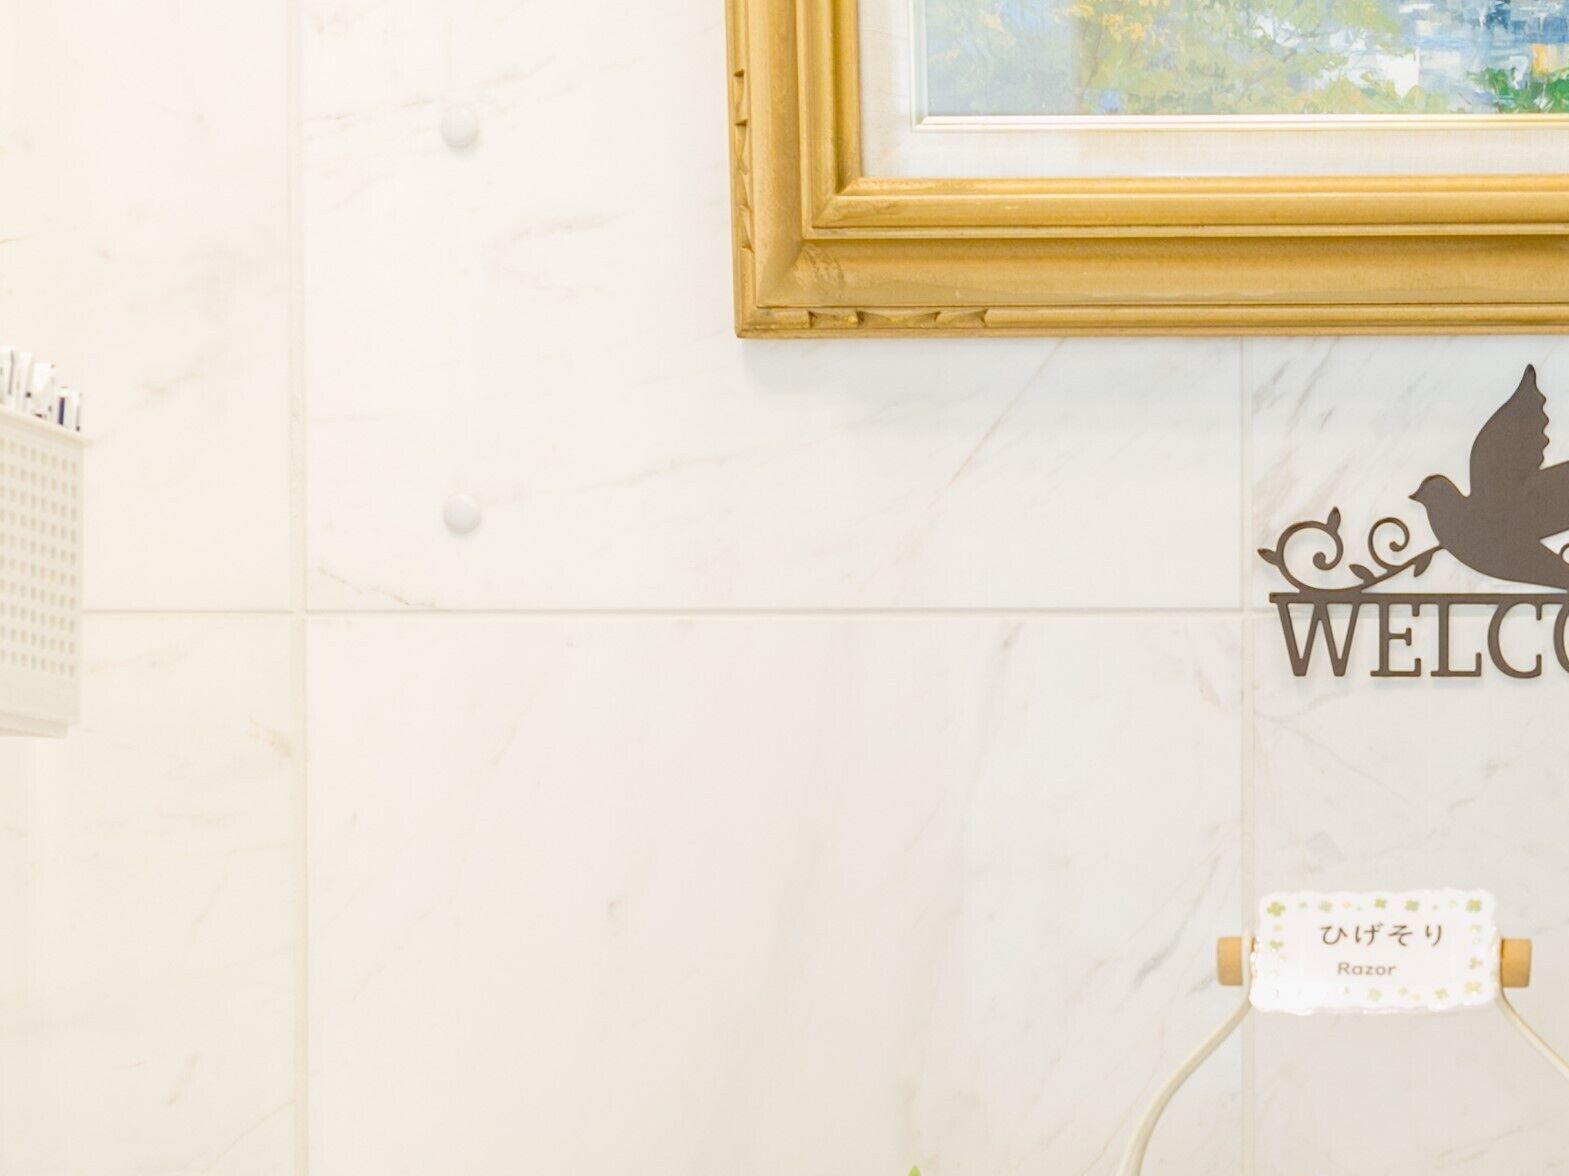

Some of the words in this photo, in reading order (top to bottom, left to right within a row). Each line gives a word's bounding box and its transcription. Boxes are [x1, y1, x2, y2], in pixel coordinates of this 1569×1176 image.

[1321, 922, 1443, 947] ひげそり
[1337, 961, 1397, 976] Razor
